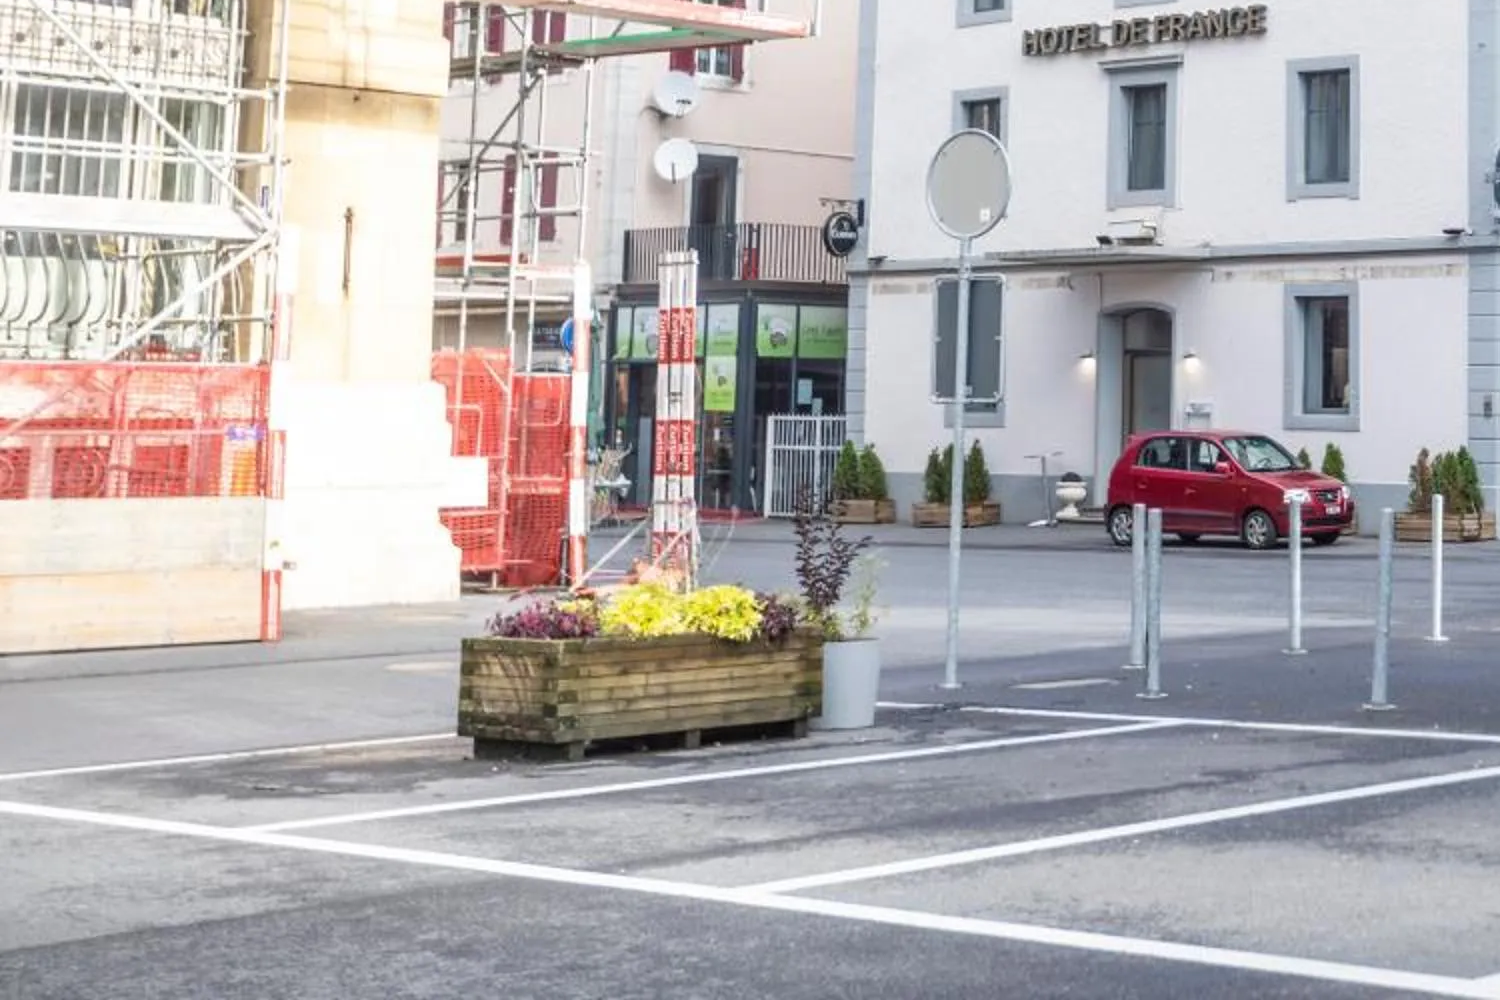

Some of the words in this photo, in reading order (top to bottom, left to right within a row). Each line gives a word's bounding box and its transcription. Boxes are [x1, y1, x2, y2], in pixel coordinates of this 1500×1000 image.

[1022, 23, 1107, 56] HOTEL
[1112, 17, 1149, 48] DE
[1153, 3, 1267, 44] FRANCE
